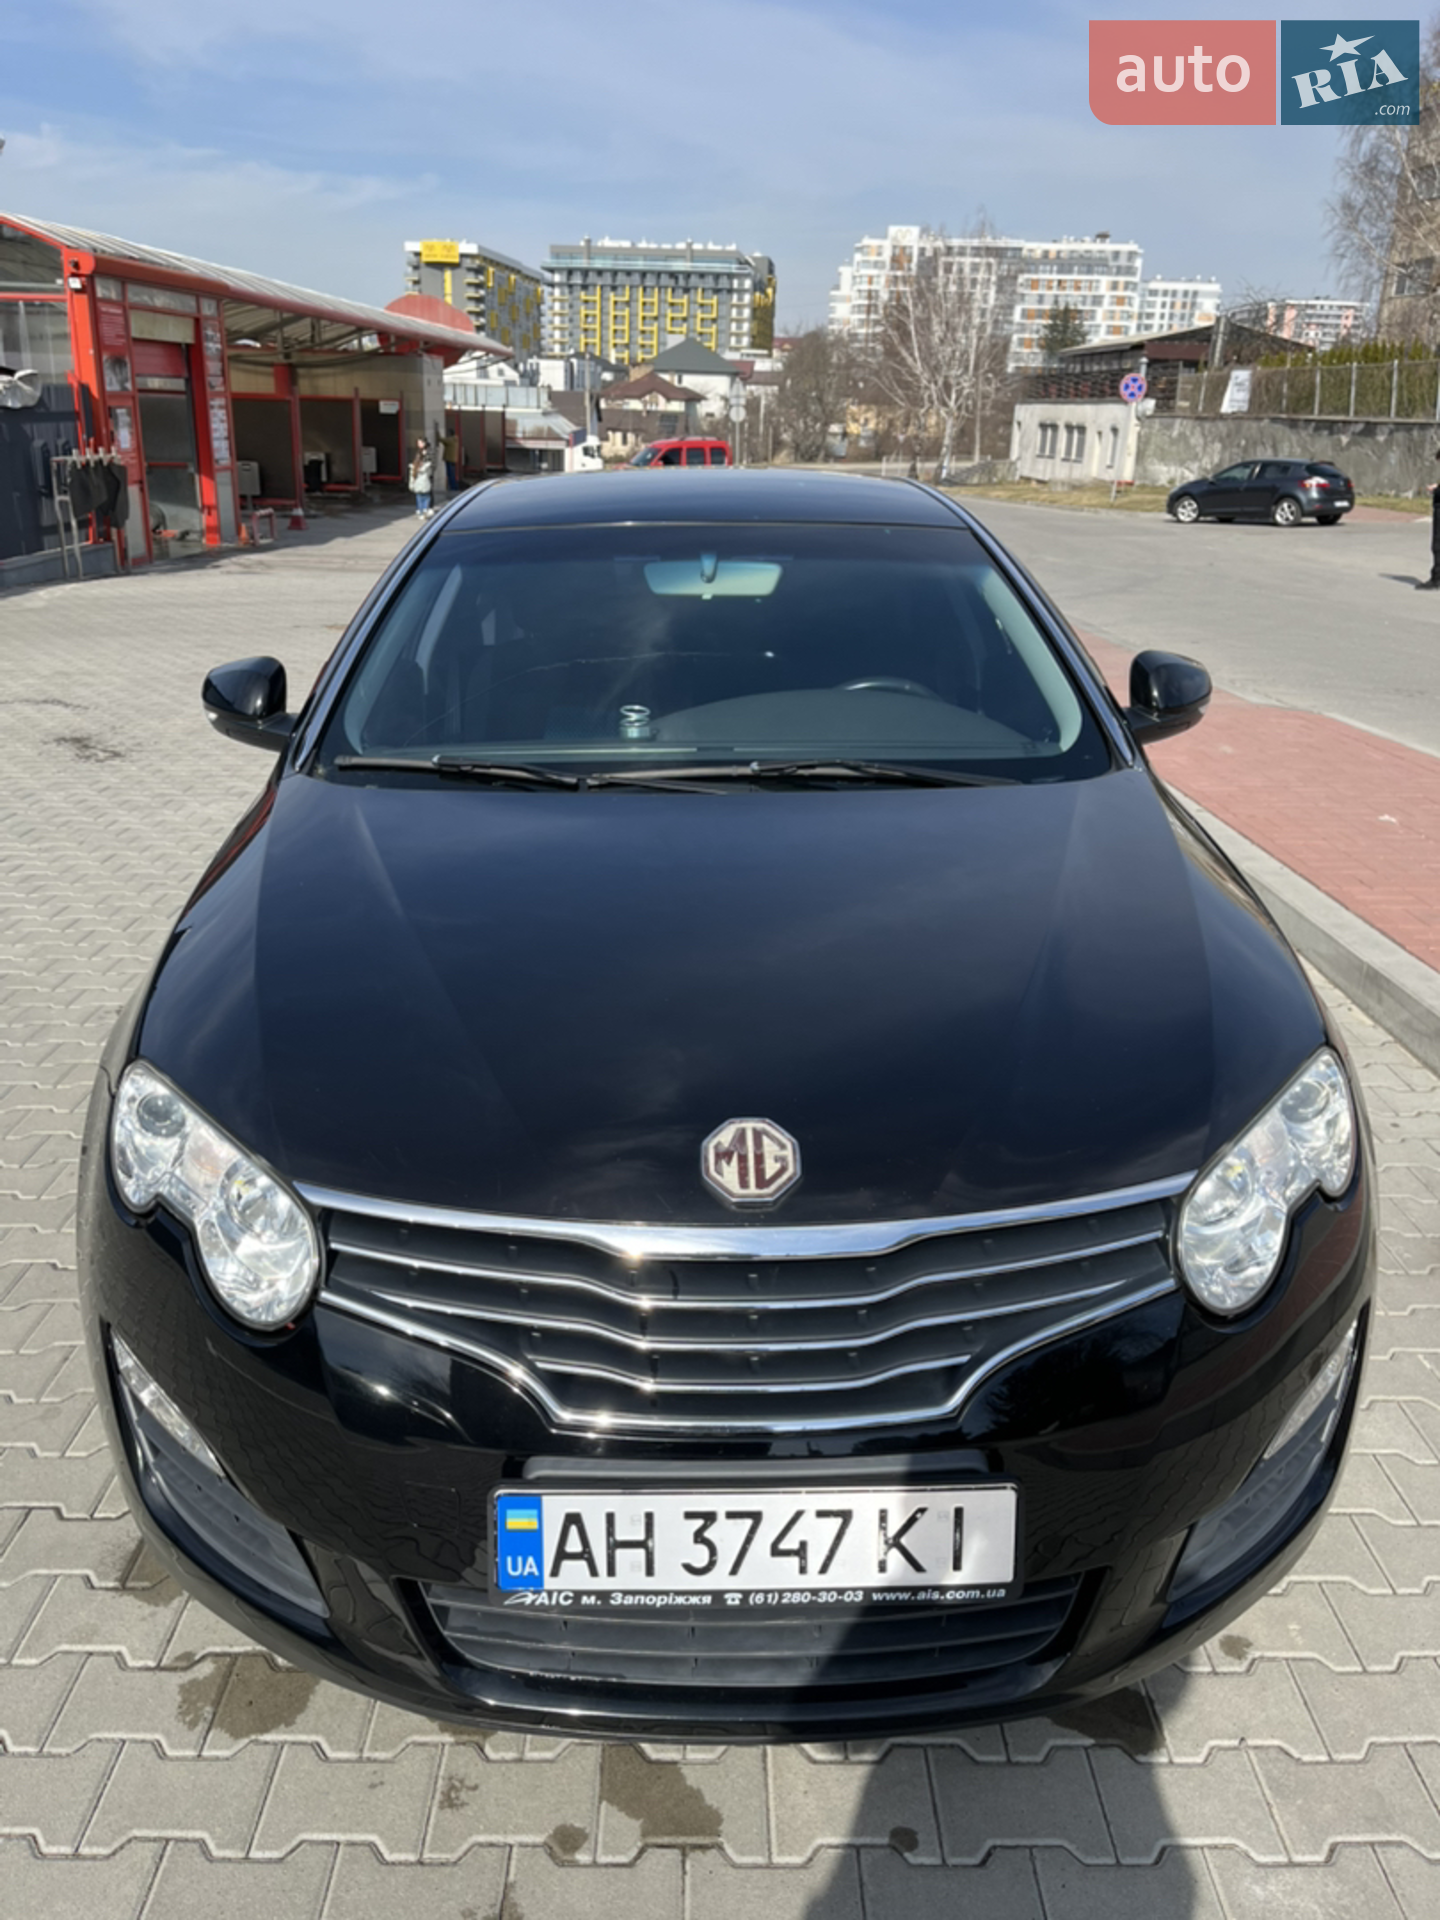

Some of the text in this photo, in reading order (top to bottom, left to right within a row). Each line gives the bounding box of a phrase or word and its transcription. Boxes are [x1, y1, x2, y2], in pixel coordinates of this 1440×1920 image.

[713, 1126, 790, 1190] MG
[550, 1506, 965, 1578] AH 3747 KI
[506, 1556, 539, 1578] UA
[609, 1592, 712, 1607] Запоріжжя
[749, 1592, 779, 1605] (61)
[781, 1590, 864, 1603] 280-30-03
[872, 1588, 1006, 1602] www.ais.com.ua
